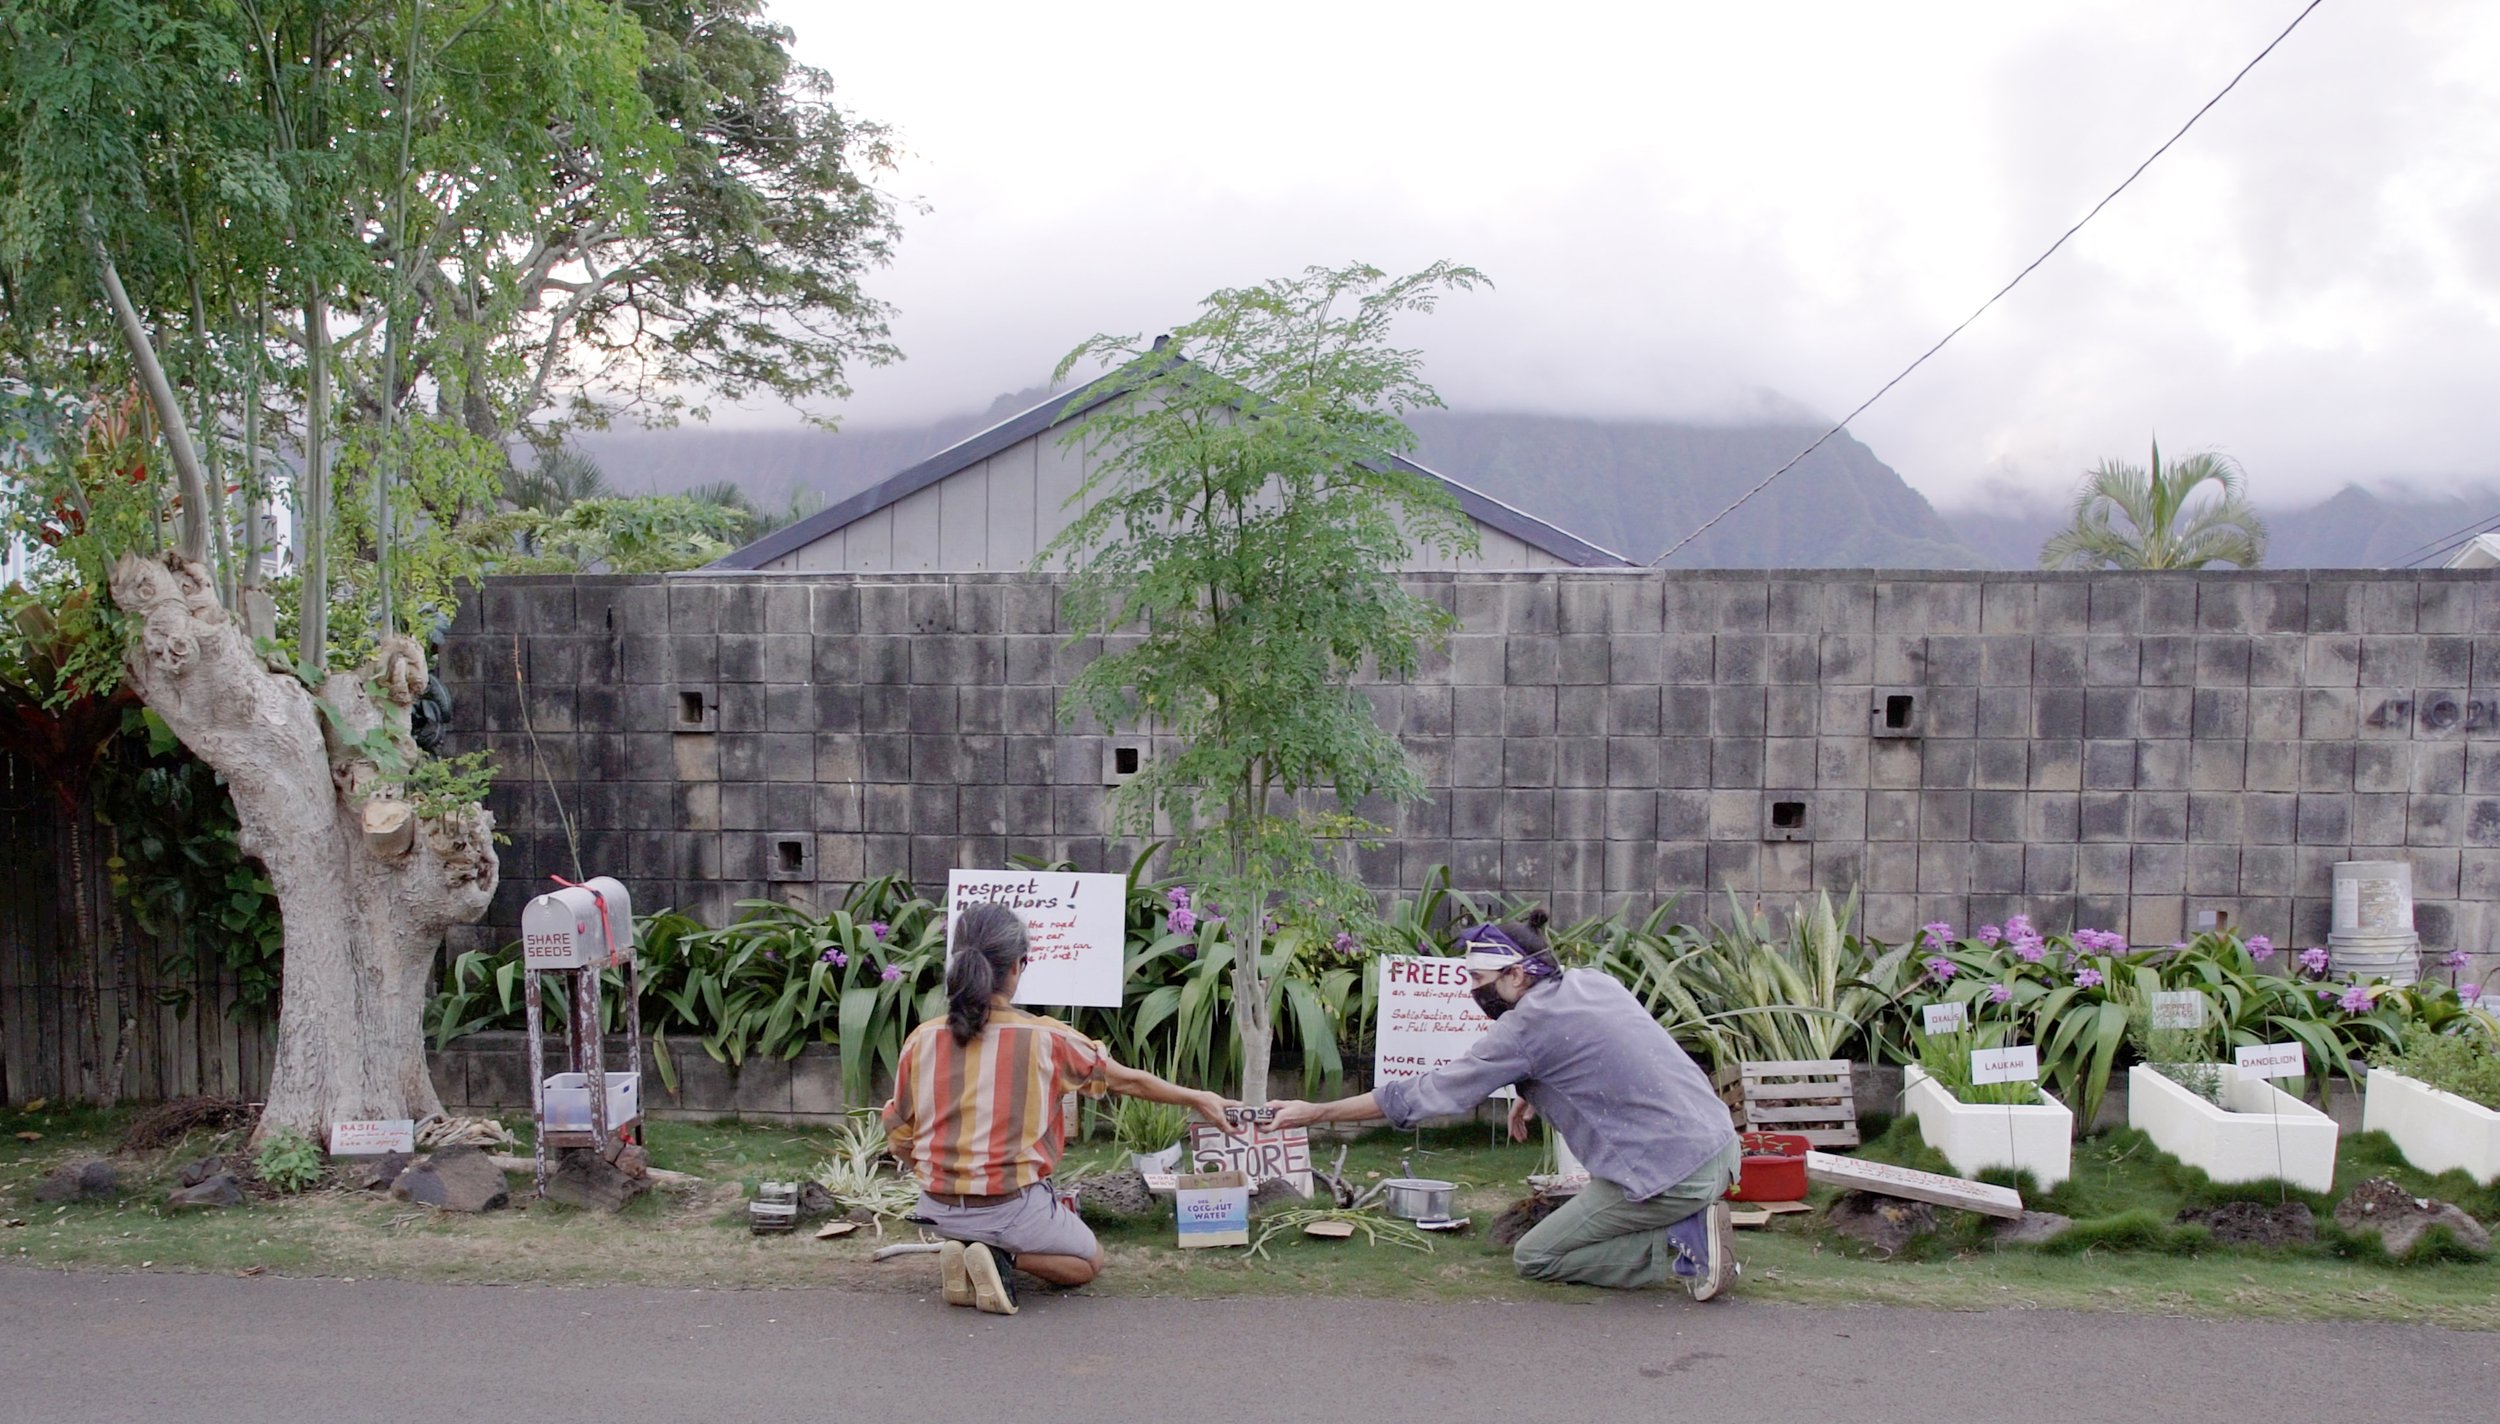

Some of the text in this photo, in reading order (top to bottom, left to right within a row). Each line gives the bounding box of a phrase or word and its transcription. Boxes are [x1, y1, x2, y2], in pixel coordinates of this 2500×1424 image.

[957, 877, 1039, 902] respect
[957, 895, 1058, 911] nhbors
[1050, 915, 1077, 929] road
[527, 933, 571, 945] SHARE
[528, 946, 572, 957] SEEDS
[1931, 1013, 1960, 1024] OXALIS
[1406, 1021, 1428, 1032] Full
[1383, 1055, 1451, 1066] MORE AT
[1985, 1060, 2024, 1071] LAUKAHI
[2241, 1055, 2296, 1067] DANDELION
[340, 1123, 379, 1131] BASIL
[1194, 1142, 1312, 1178] STORE
